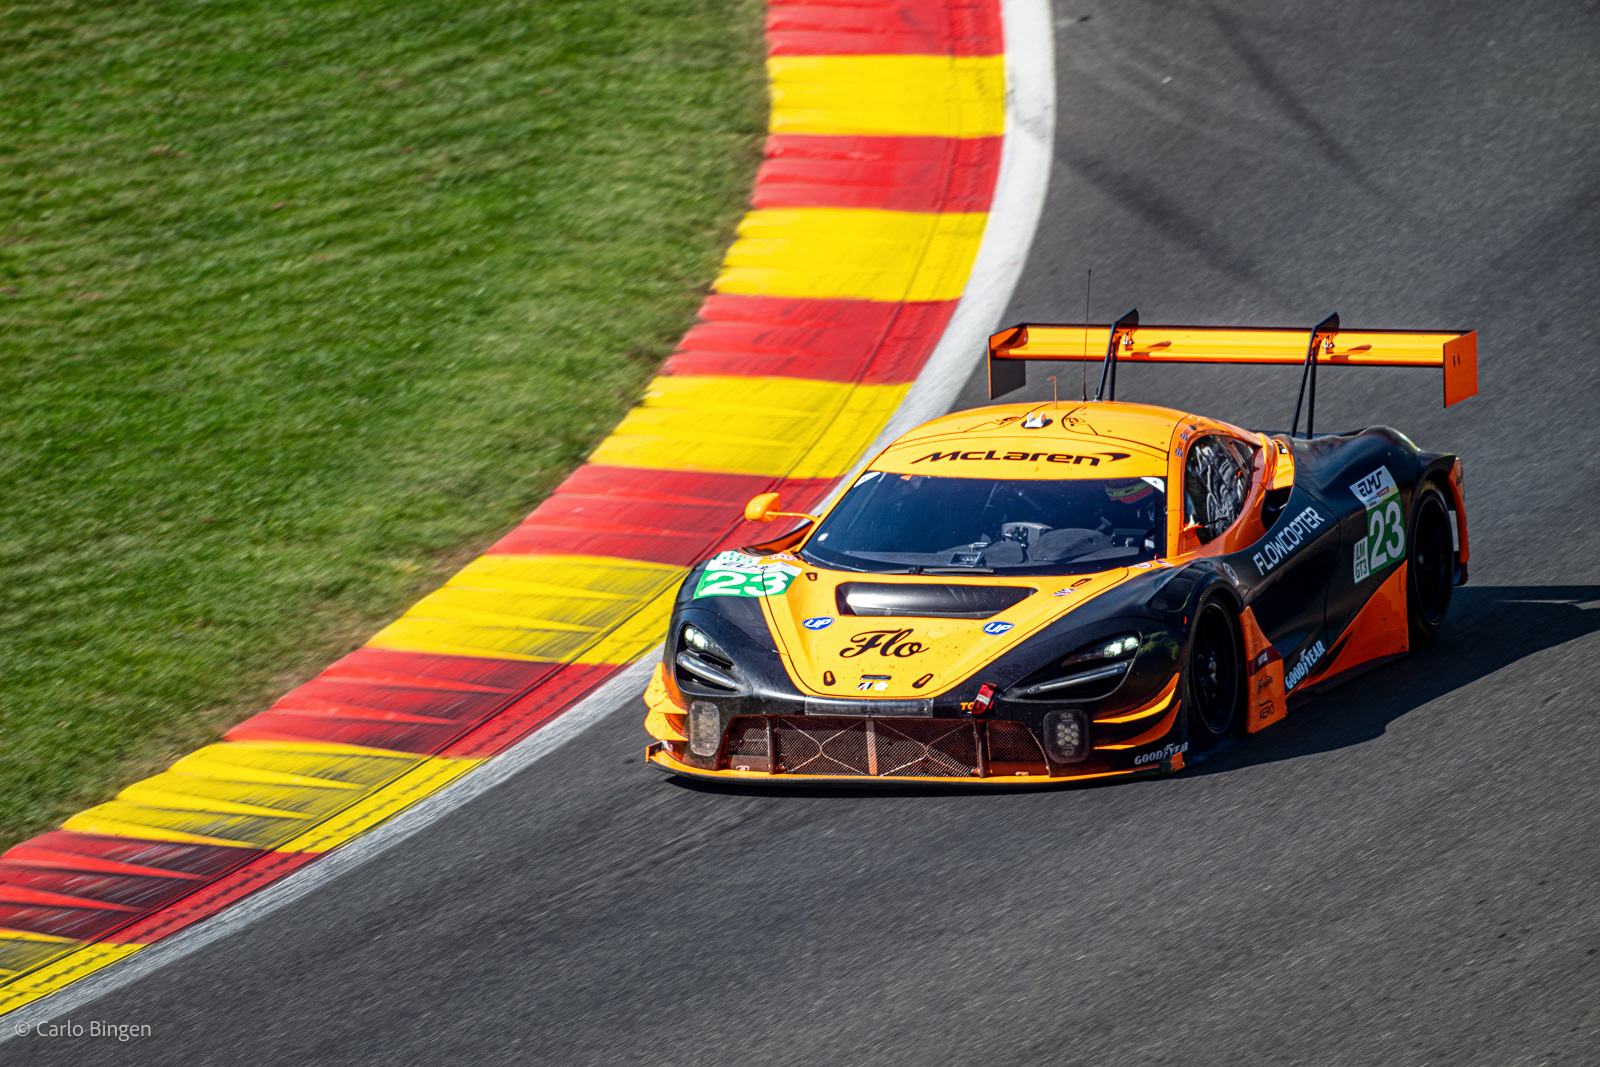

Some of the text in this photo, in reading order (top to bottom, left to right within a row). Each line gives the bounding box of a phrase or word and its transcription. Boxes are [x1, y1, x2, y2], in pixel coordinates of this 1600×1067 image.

[910, 450, 1100, 467] McLaren
[1253, 506, 1325, 576] FLOWCOPTER
[1369, 500, 1405, 570] 23
[1355, 558, 1368, 579] GT3
[697, 571, 789, 597] 23
[839, 628, 930, 658] Flo
[1285, 640, 1326, 690] GOODYEAR
[1134, 741, 1189, 765] GOODYEAR
